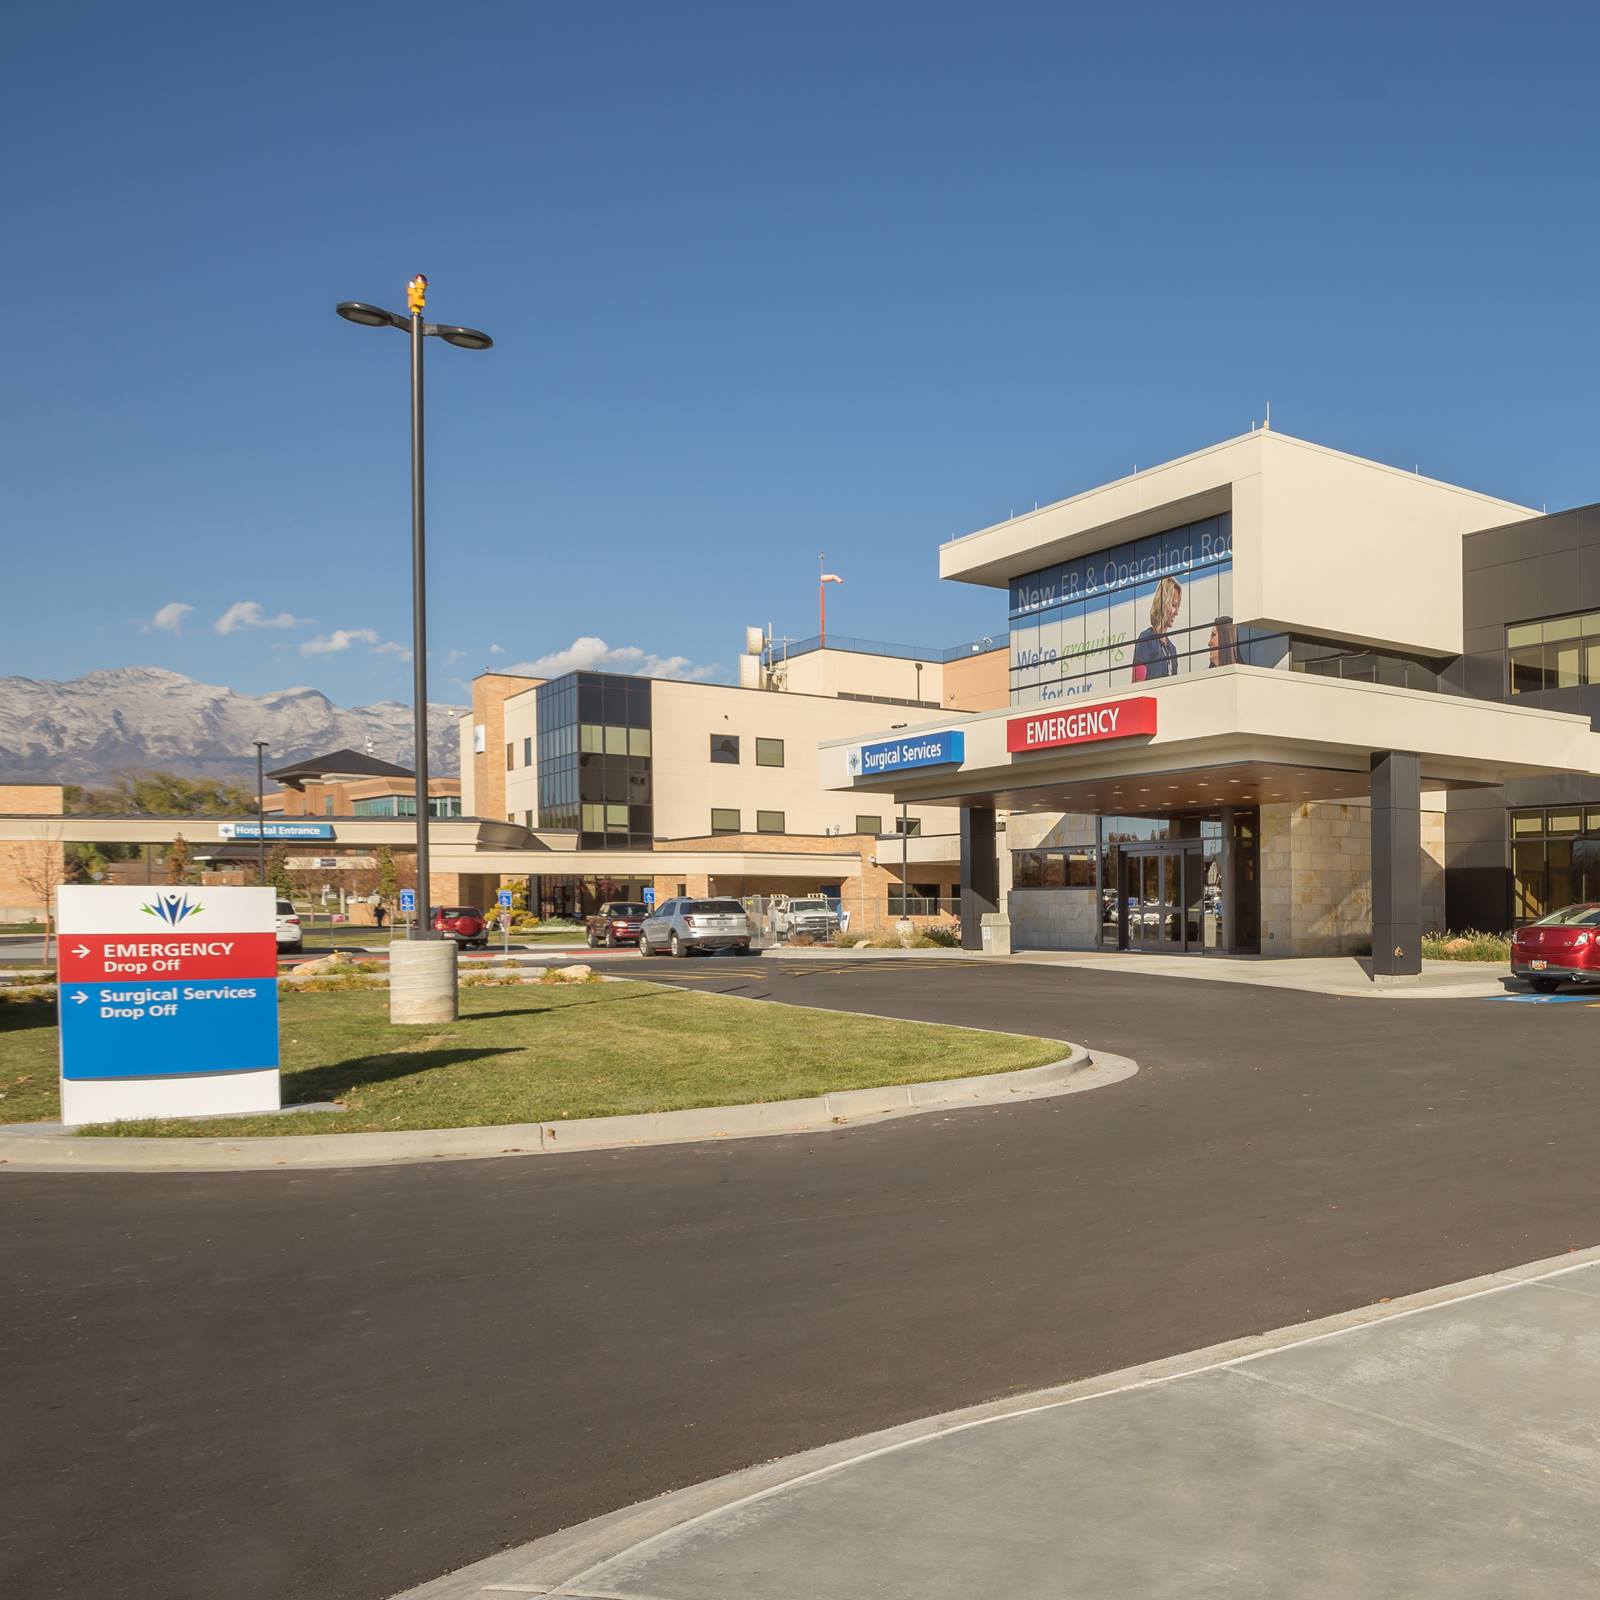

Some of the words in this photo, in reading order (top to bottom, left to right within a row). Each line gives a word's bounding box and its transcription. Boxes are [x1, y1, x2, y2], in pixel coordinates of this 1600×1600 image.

[1018, 584, 1060, 613] New
[1061, 572, 1080, 601] ER
[1086, 567, 1098, 593] &
[1103, 543, 1193, 593] Operating
[1061, 629, 1127, 672] growing
[1026, 707, 1120, 744] EMERGENCY
[865, 746, 900, 769] Surgical
[903, 741, 942, 762] Services
[236, 826, 277, 837] Hosptal
[278, 826, 321, 835] Entrance
[103, 942, 234, 958] EMERGENCY
[104, 960, 148, 974] Drop
[152, 959, 181, 971] Off
[100, 987, 178, 1005] Surgical
[183, 986, 257, 1000] Services
[100, 1006, 145, 1020] Drop
[149, 1004, 179, 1017] Off
